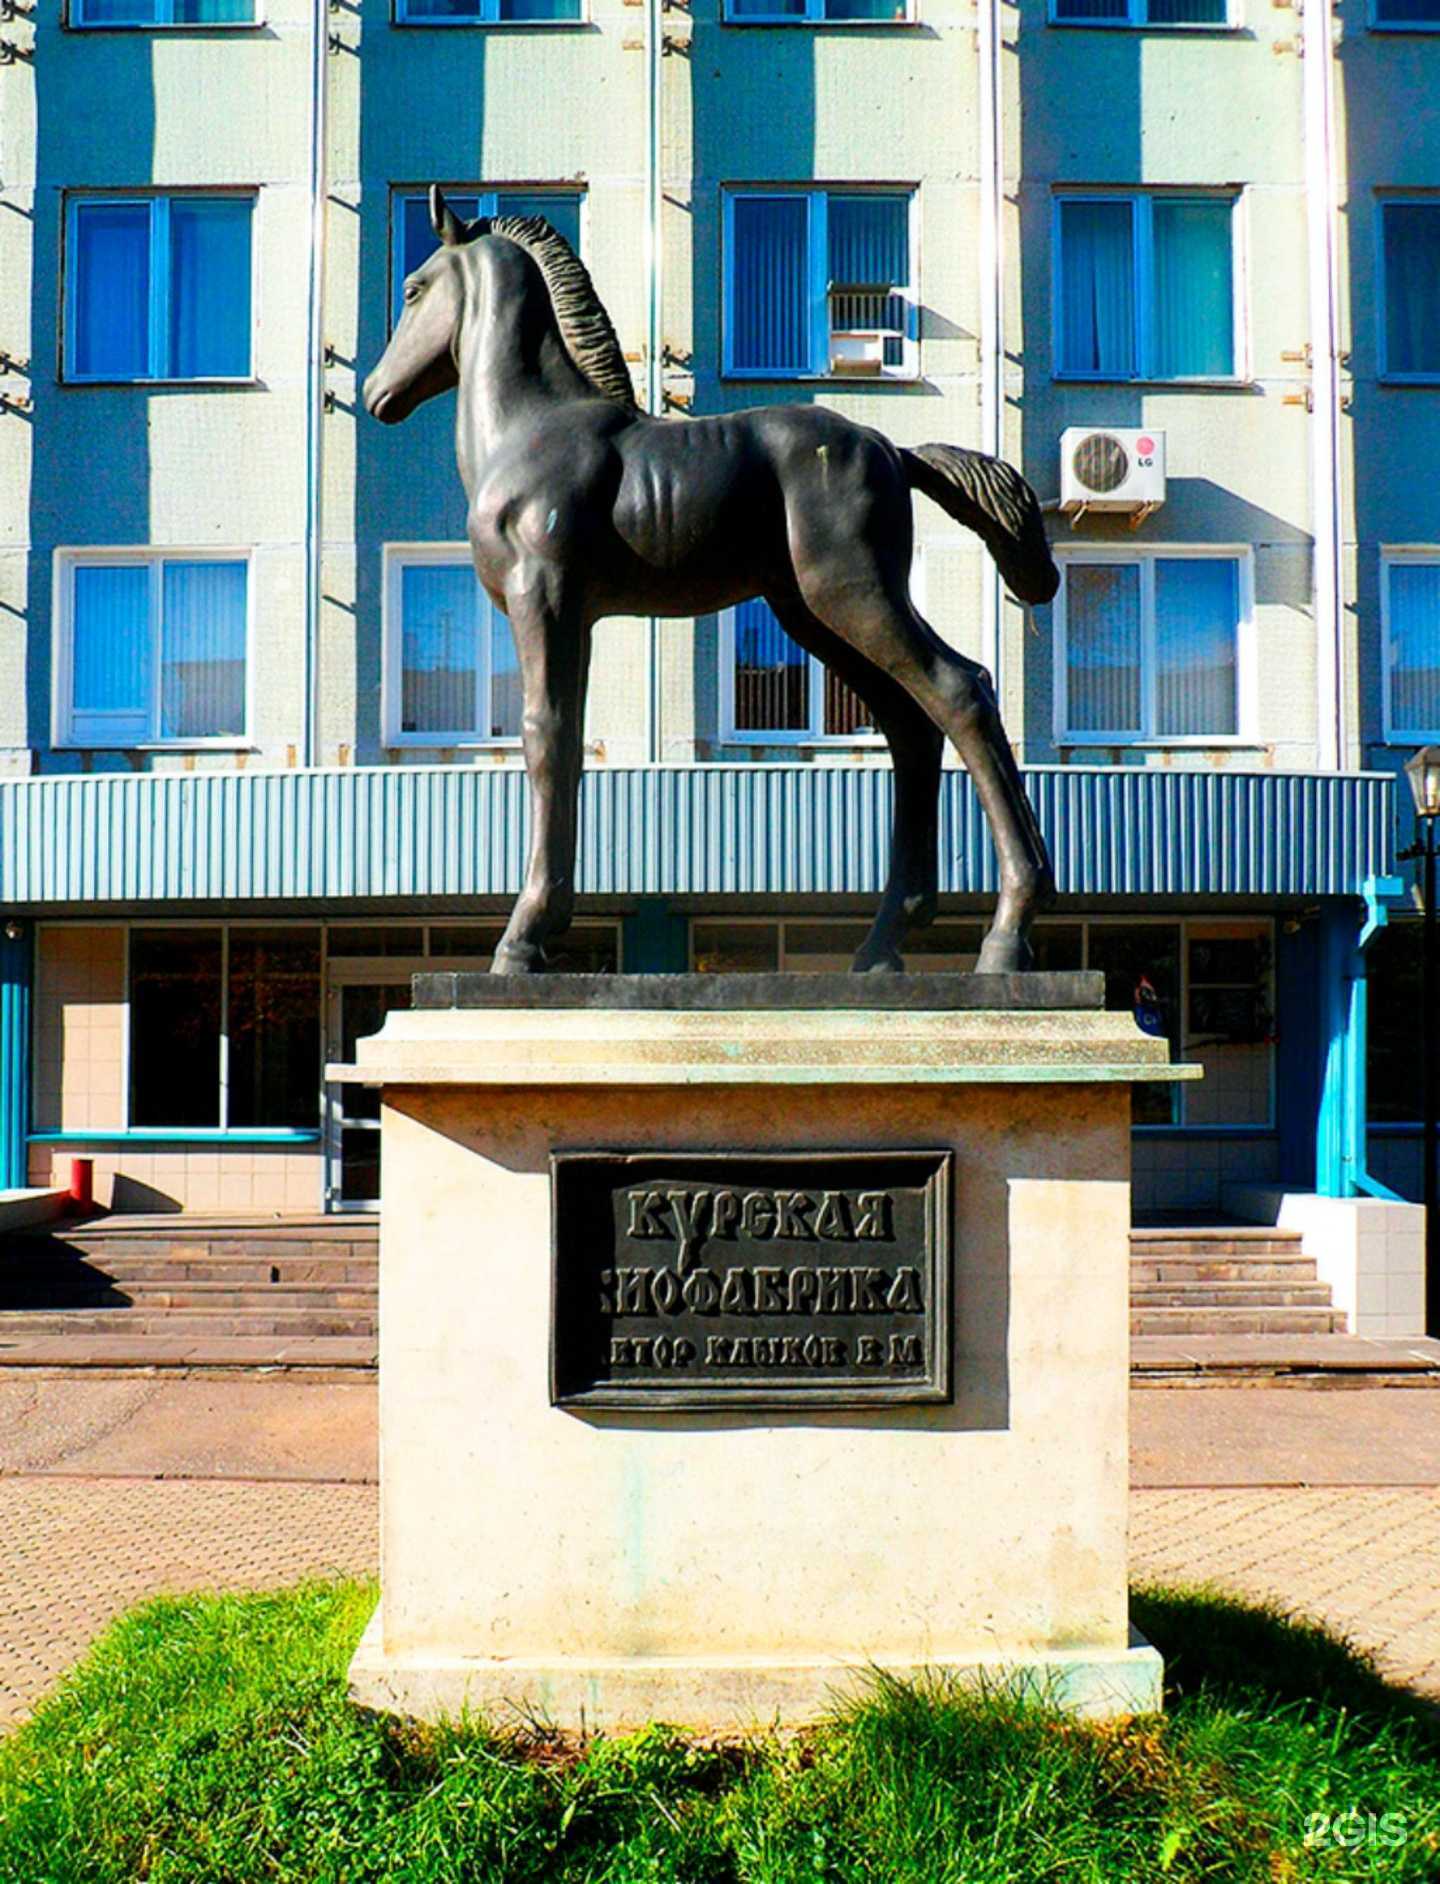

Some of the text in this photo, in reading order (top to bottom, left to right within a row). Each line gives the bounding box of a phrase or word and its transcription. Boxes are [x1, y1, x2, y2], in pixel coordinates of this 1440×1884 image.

[1138, 457, 1153, 467] LG
[626, 1191, 894, 1274] КУРСКАЯ
[600, 1334, 693, 1368] ВТОР
[854, 1334, 883, 1366] В
[887, 1333, 924, 1367] М
